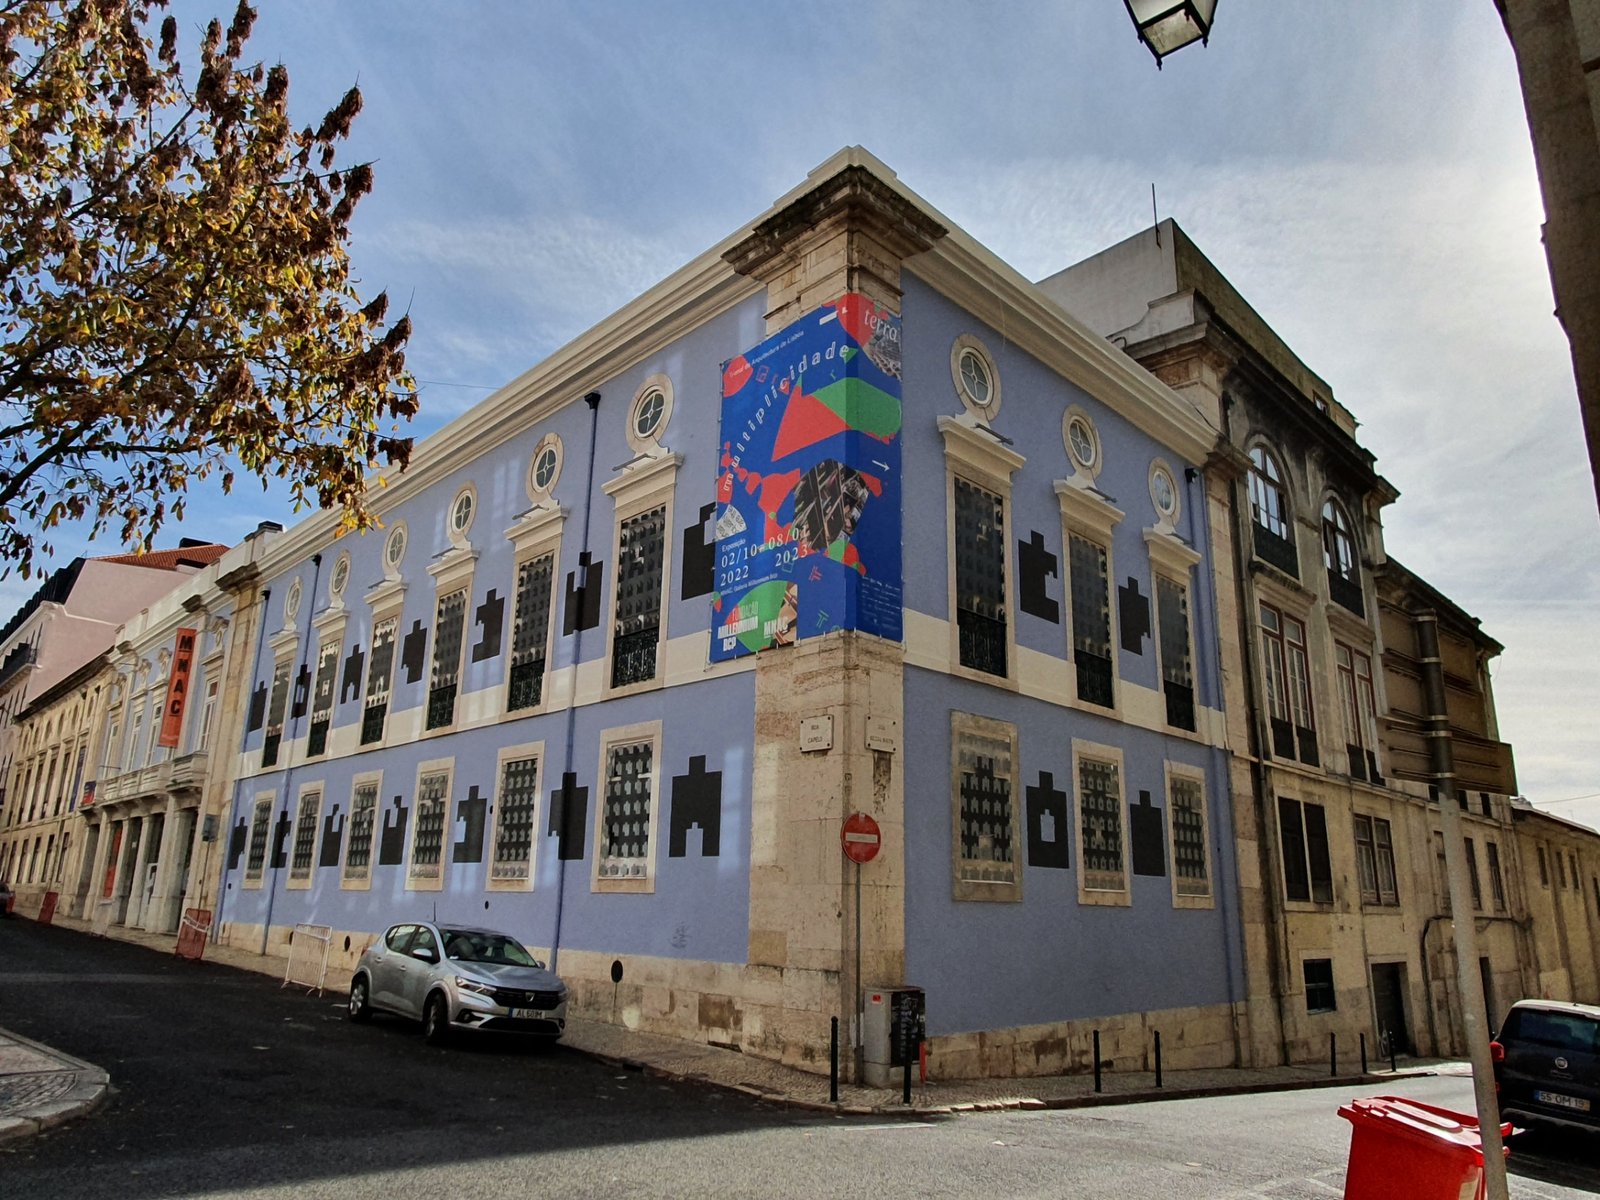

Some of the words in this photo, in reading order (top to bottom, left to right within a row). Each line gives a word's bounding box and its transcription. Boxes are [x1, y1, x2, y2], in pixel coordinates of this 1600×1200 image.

[864, 309, 898, 342] terra
[720, 565, 749, 587] 2022
[775, 544, 808, 567] 2023
[169, 635, 193, 716] MNAC
